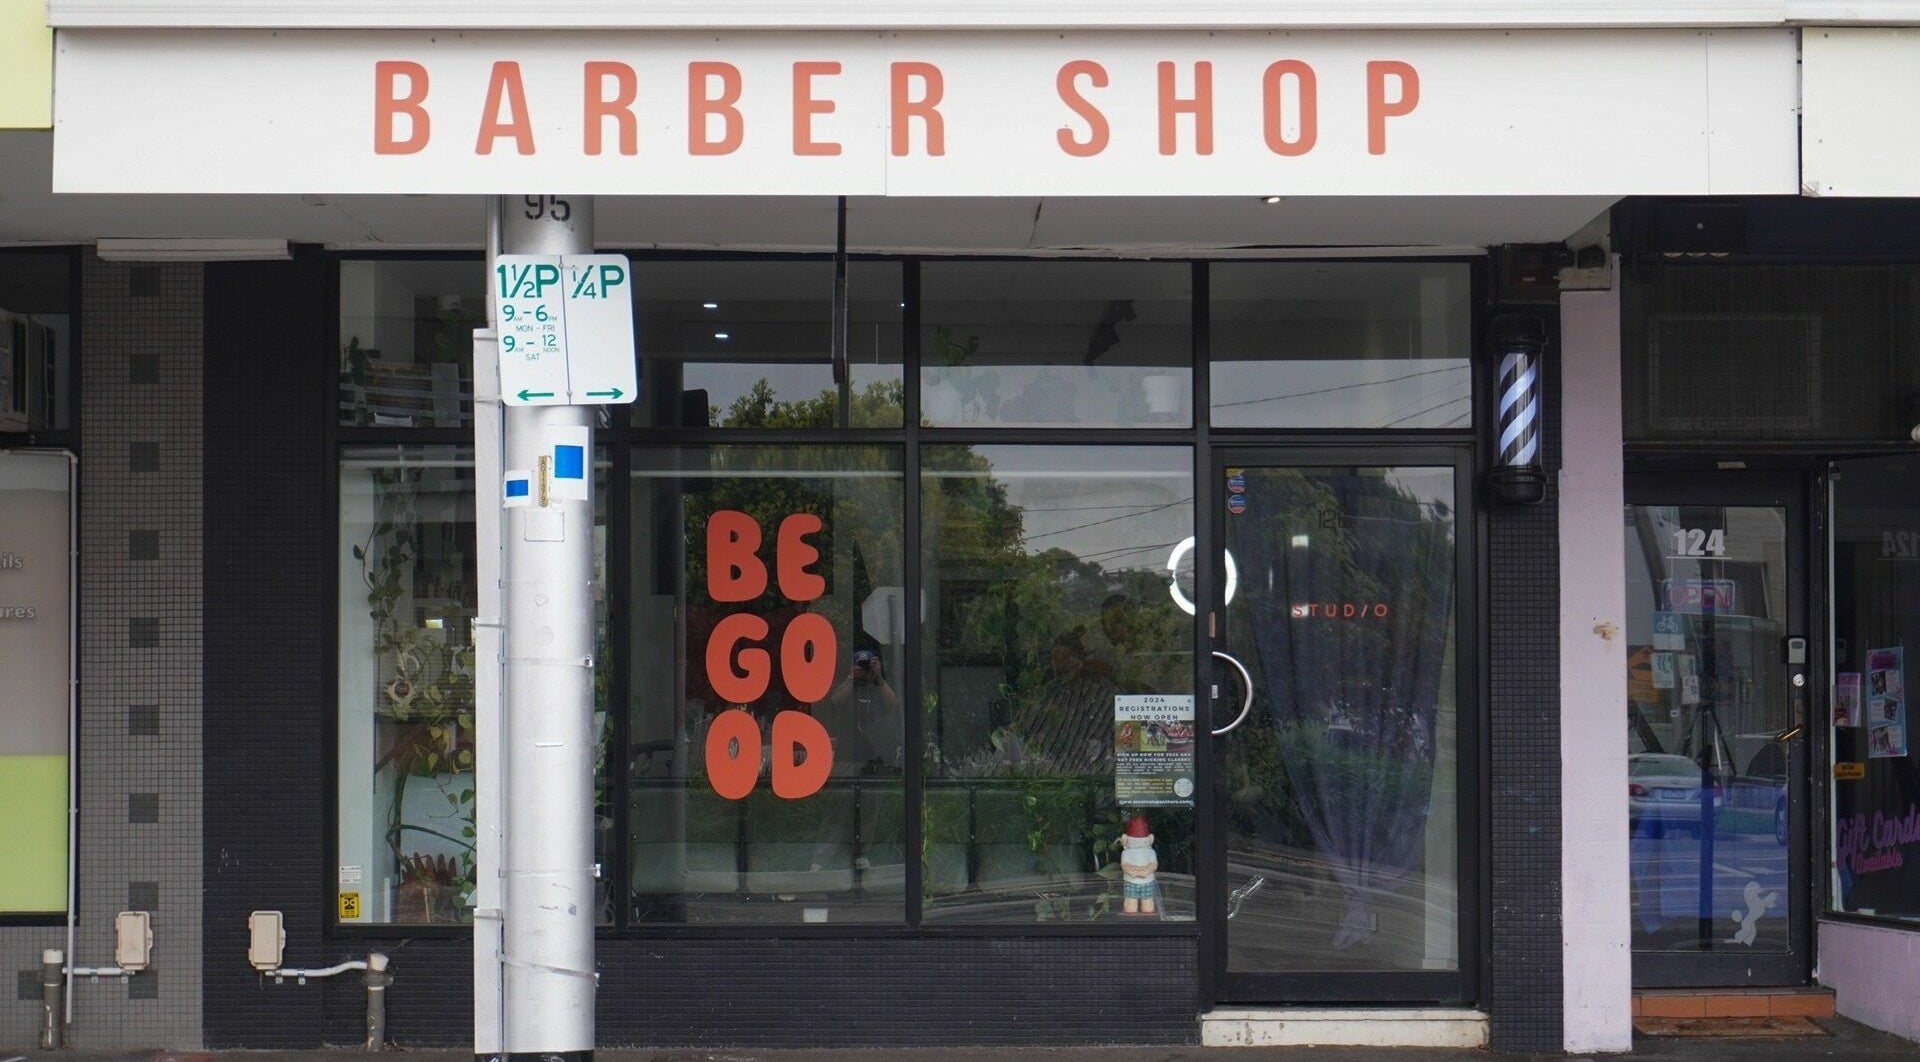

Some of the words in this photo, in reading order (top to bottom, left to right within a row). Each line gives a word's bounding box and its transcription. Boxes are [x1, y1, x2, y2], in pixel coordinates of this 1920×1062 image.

[374, 61, 945, 156] BARBER
[1056, 59, 1420, 157] SHOP
[525, 194, 570, 221] 95
[0, 552, 23, 569] ils
[707, 509, 825, 602] BE
[1673, 528, 1725, 555] 124
[705, 612, 837, 703] GO
[705, 709, 833, 800] OD
